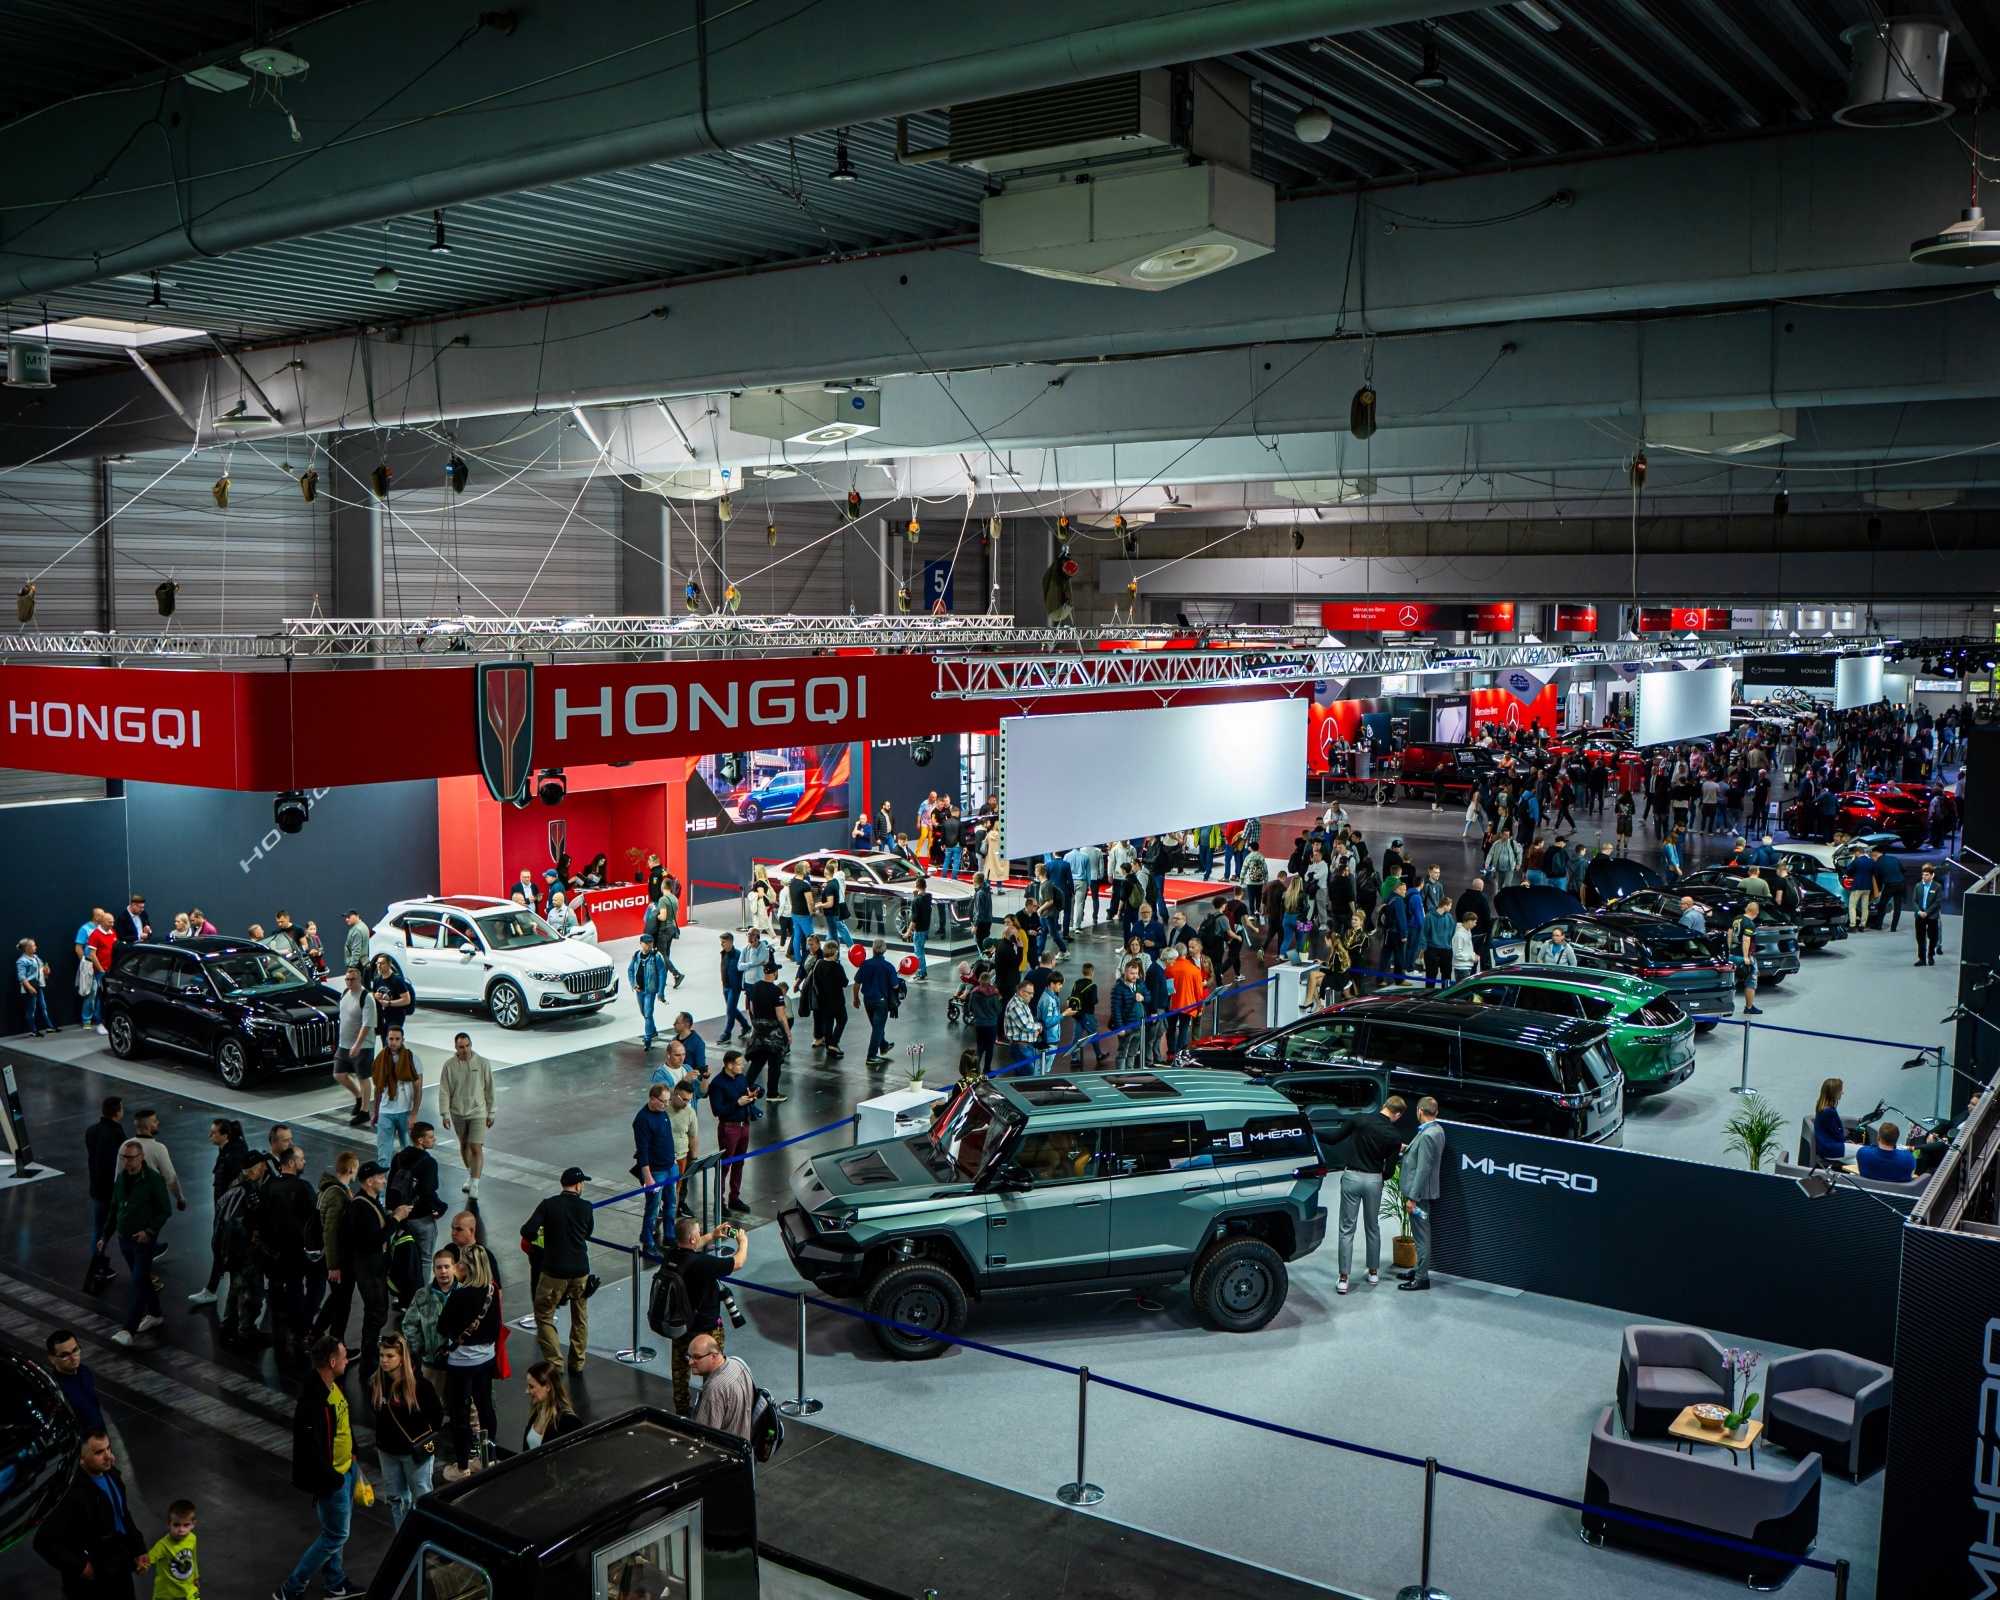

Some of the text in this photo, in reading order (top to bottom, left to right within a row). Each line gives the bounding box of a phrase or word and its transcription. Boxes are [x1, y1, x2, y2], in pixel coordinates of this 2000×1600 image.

[1947, 233, 1968, 241] BOSCH
[26, 355, 47, 366] M11
[934, 569, 945, 593] 5
[554, 675, 867, 740] HONGQI
[9, 700, 201, 749] HONGQI
[591, 895, 649, 913] HONGQI
[1249, 1128, 1303, 1141] MHERO
[1461, 1153, 1598, 1193] MHERO
